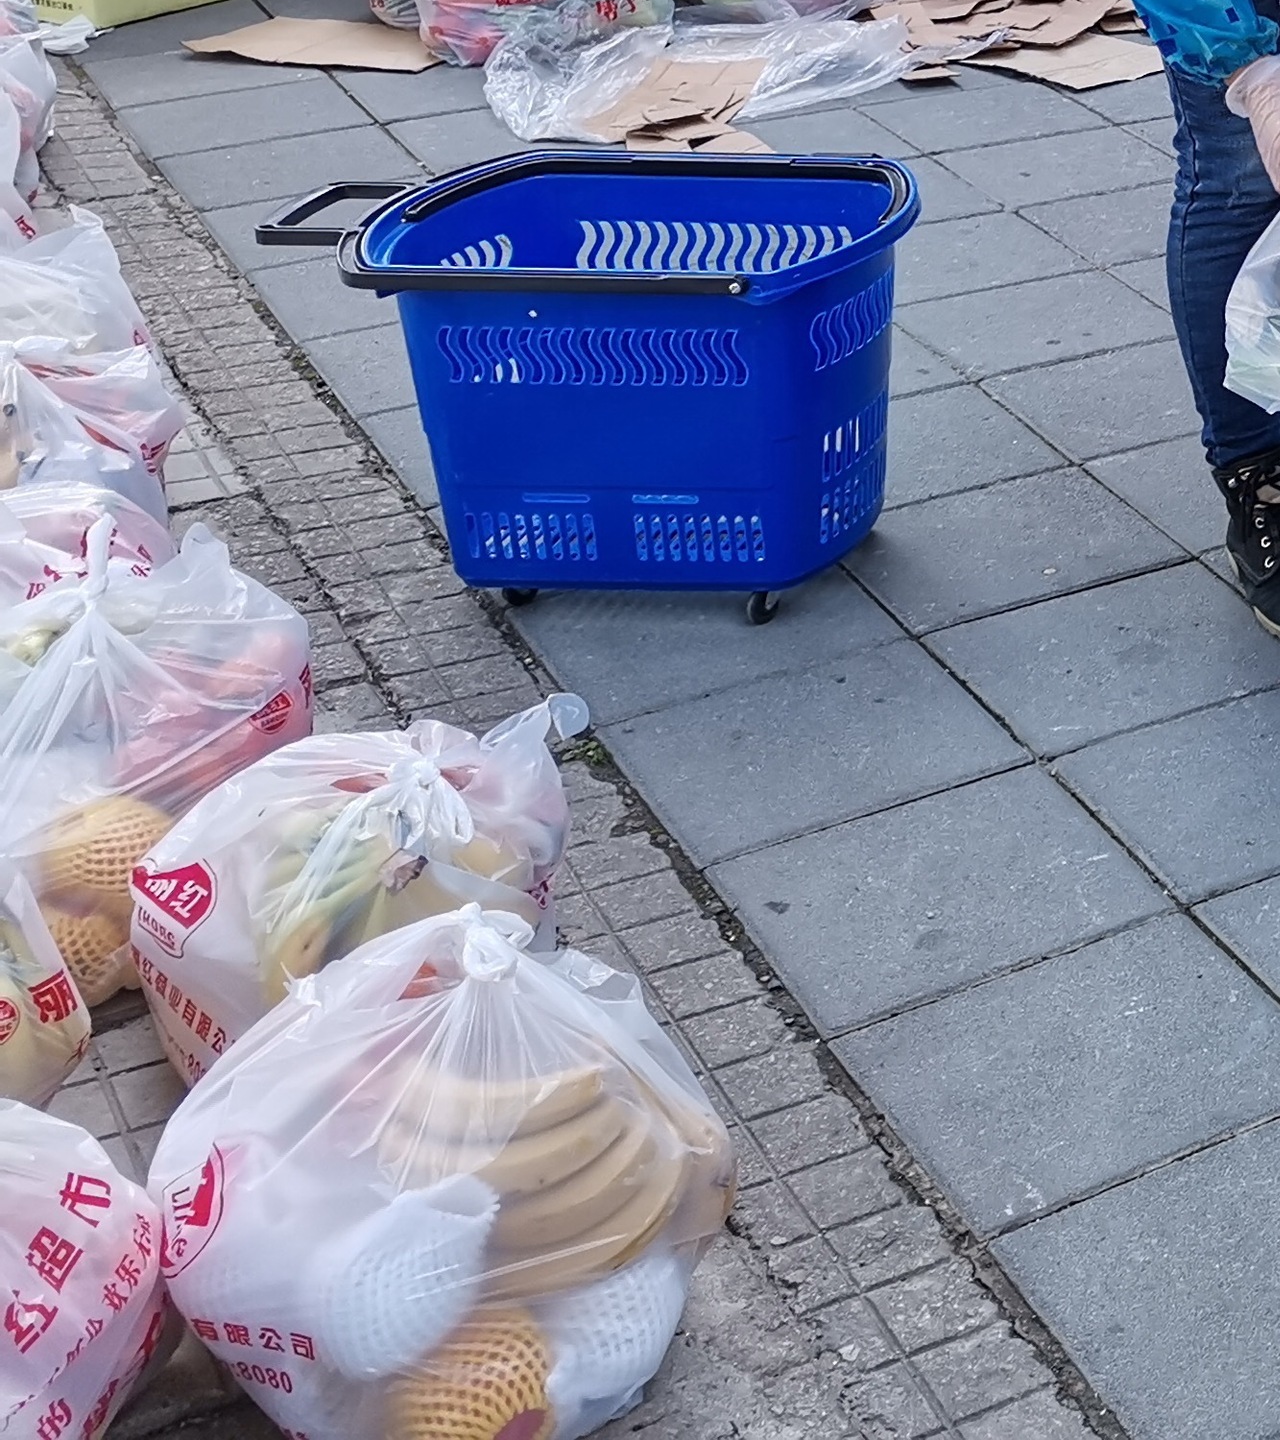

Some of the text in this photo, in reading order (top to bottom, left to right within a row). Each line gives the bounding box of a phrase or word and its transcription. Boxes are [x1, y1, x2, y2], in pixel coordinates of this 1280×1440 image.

[144, 878, 208, 919] 丽红
[190, 1318, 316, 1361] 有限公司
